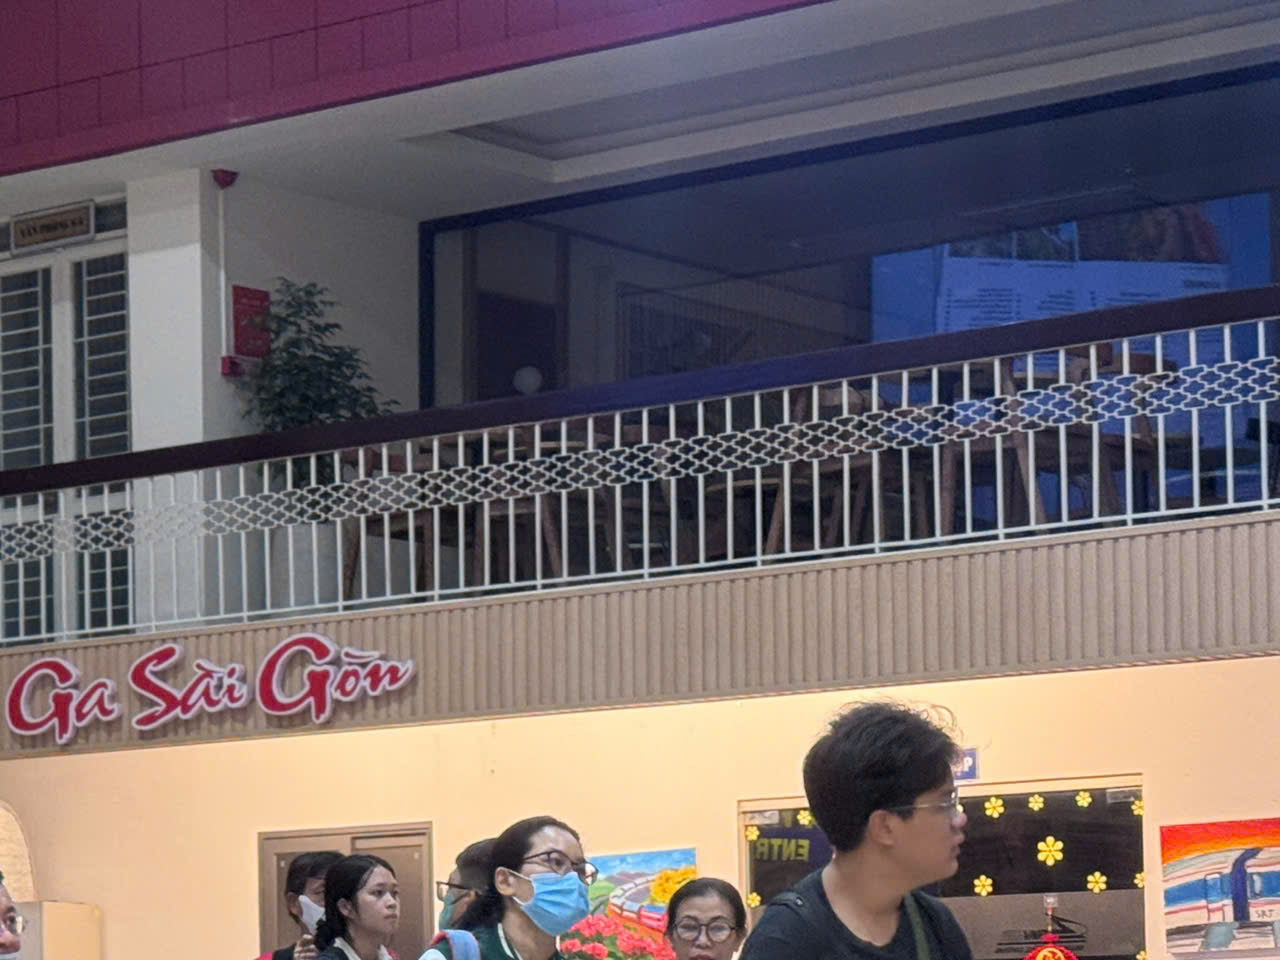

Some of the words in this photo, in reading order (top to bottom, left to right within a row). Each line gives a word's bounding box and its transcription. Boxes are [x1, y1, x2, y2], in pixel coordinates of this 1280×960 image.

[6, 656, 120, 744] Ga
[129, 643, 247, 730] Sài
[257, 632, 414, 724] Gòn
